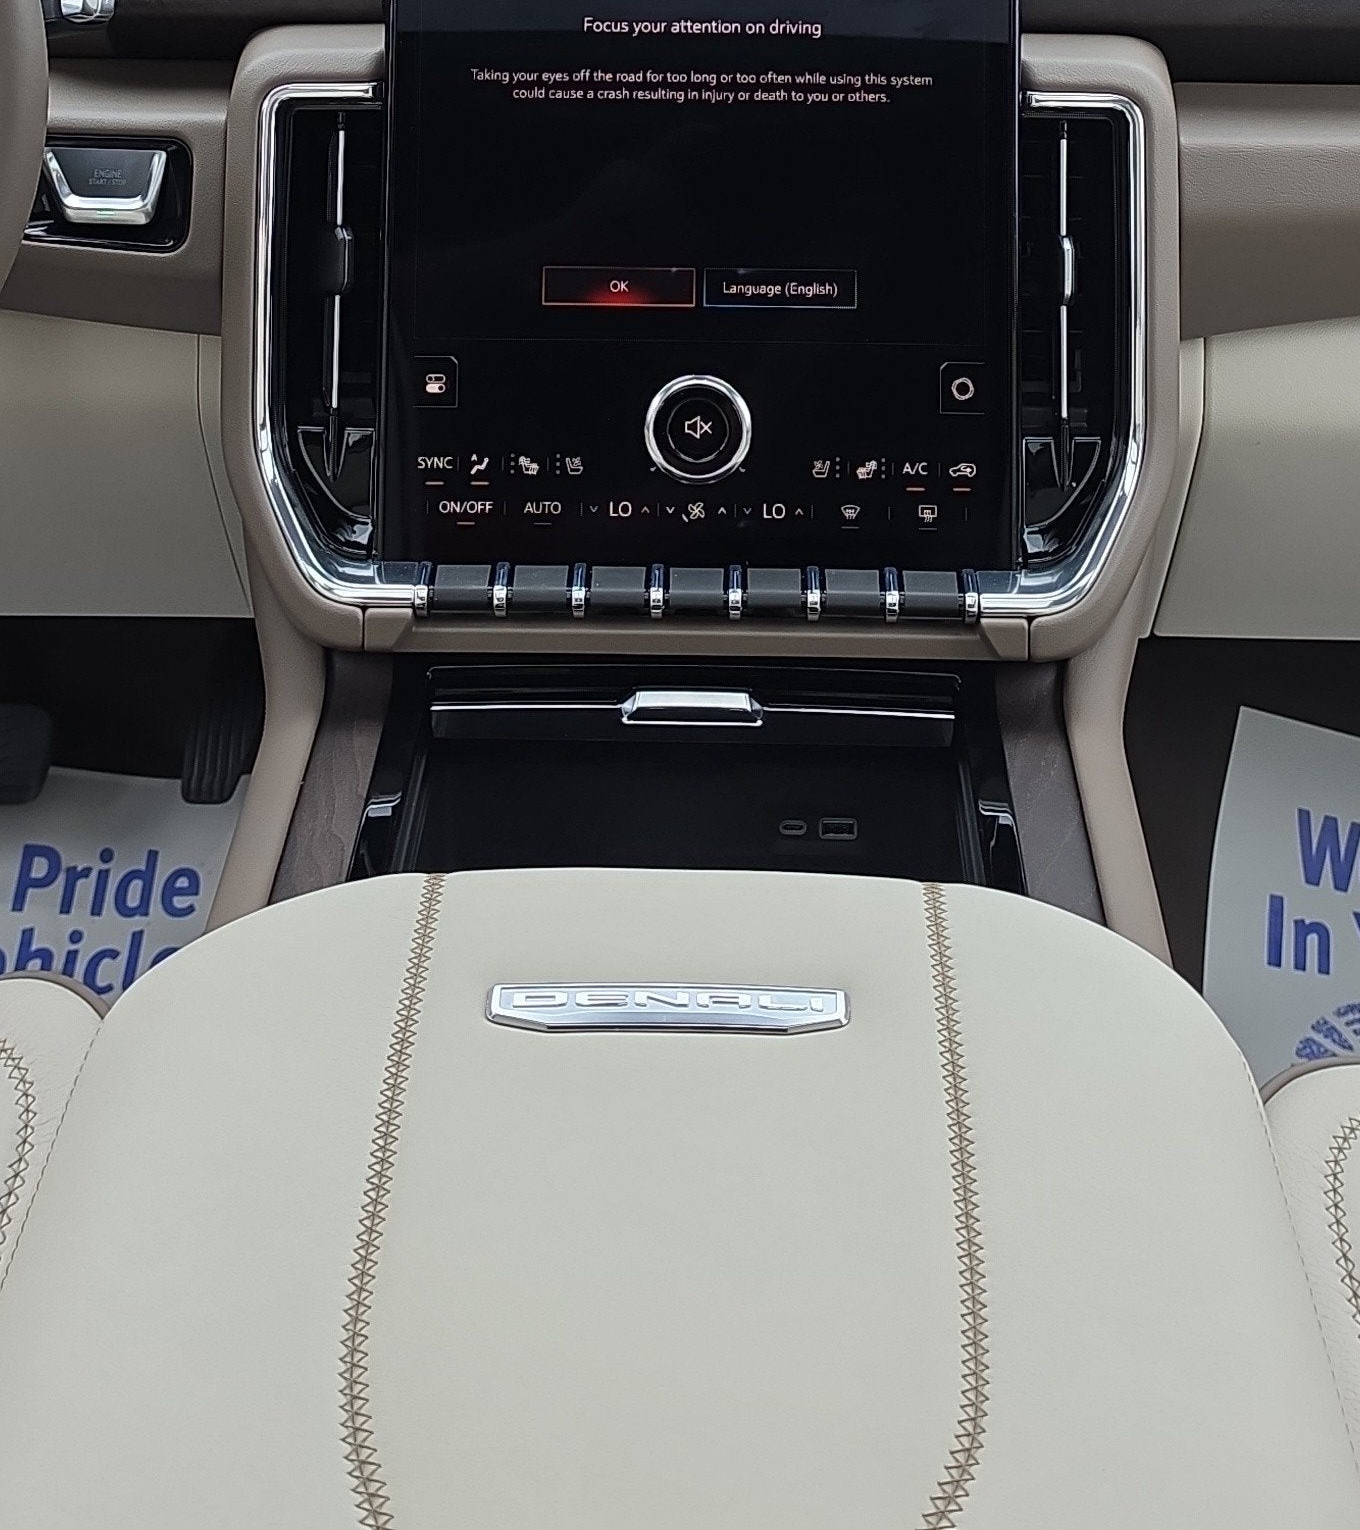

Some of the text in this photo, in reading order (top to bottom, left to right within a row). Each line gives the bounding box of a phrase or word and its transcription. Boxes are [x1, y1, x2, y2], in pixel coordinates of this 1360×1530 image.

[583, 17, 822, 39] Focus your attention on driving
[471, 68, 933, 88] Taking your eyes off the road for too long or too often while using this system
[512, 87, 891, 105] could cause a crash resulting in injury or death to you or others.
[93, 169, 122, 179] ENGINE
[609, 280, 630, 294] OK
[723, 281, 839, 299] Language (English)
[417, 456, 454, 470] SYNC
[902, 462, 929, 476] A/C
[439, 500, 494, 514] ON/OFF
[523, 501, 562, 515] AUTO
[609, 501, 633, 517] LO
[762, 503, 786, 519] LO
[10, 843, 202, 920] Pride
[1265, 894, 1332, 976] In
[510, 989, 826, 1013] DENALI
